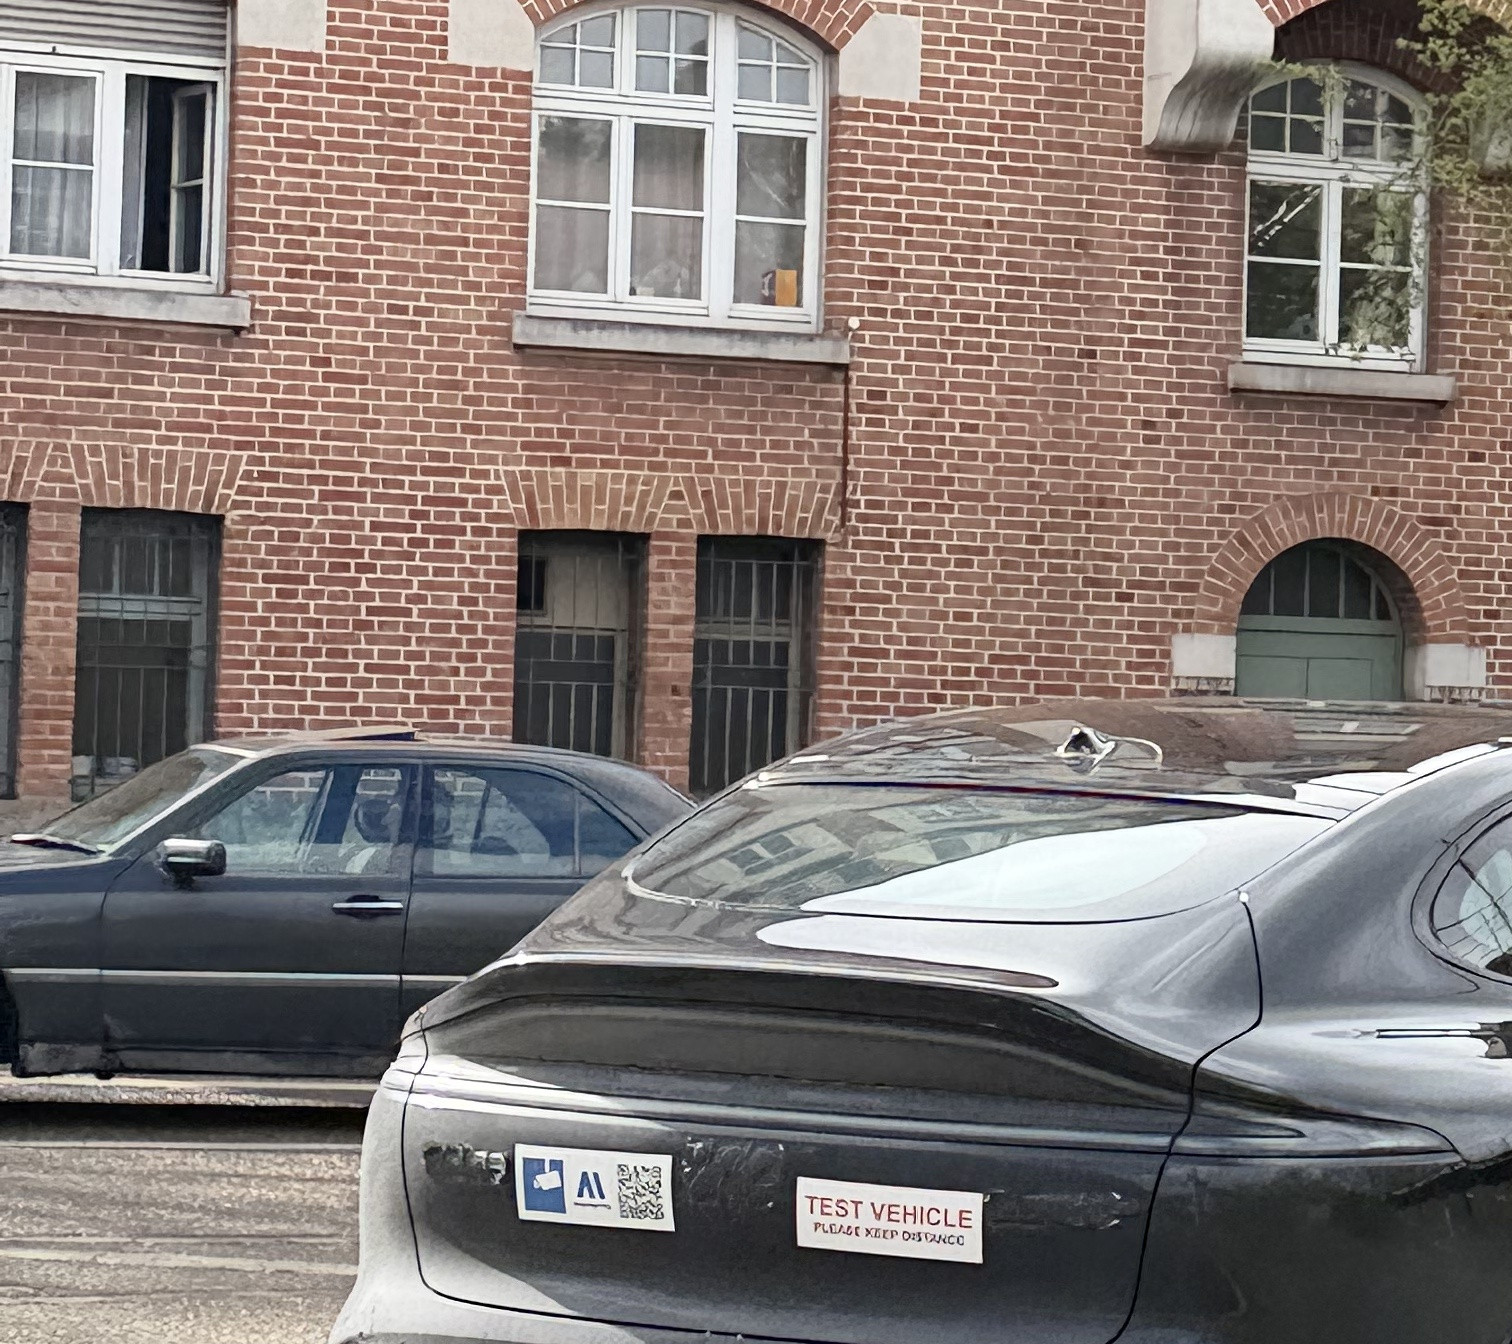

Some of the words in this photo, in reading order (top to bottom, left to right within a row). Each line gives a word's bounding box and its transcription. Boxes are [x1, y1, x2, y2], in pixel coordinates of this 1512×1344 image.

[804, 1195, 864, 1219] TEST
[872, 1201, 974, 1229] VEHICLE
[813, 1221, 861, 1238] PLEASE
[864, 1226, 898, 1243] KEEP
